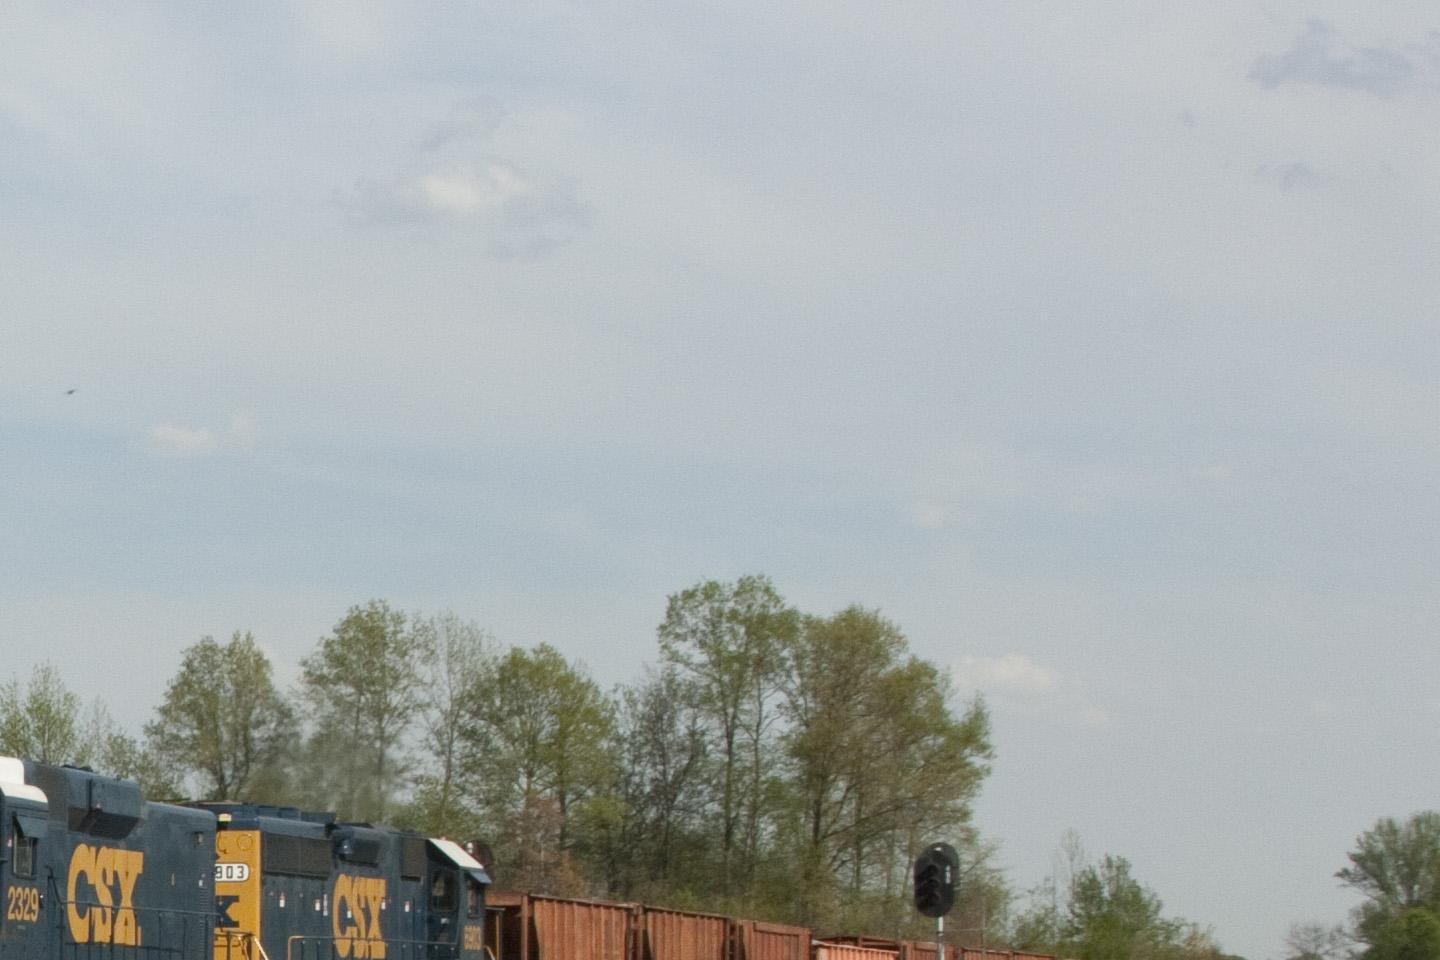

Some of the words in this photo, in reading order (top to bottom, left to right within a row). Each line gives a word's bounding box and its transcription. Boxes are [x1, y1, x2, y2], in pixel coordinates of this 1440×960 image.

[7, 886, 39, 922] 2329
[67, 843, 143, 946] CSX
[333, 874, 386, 959] CSX
